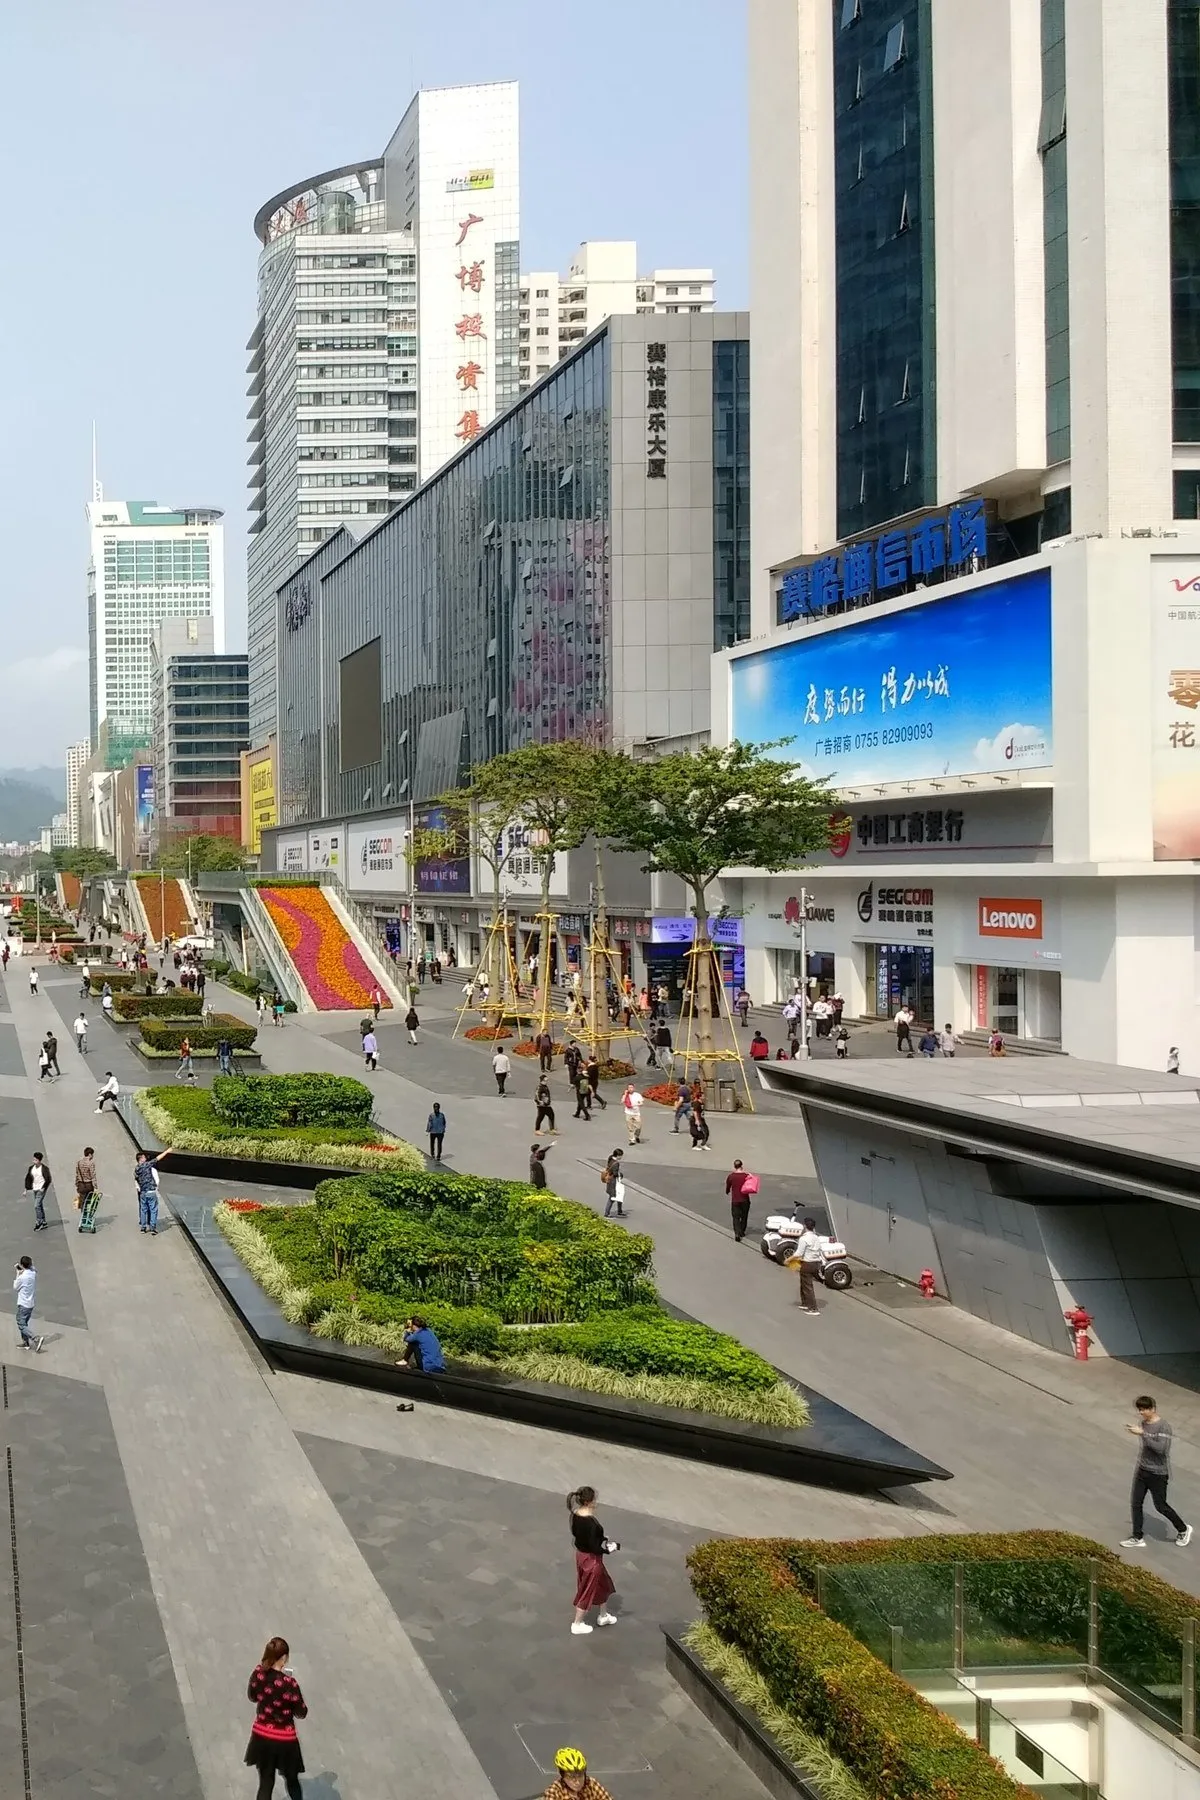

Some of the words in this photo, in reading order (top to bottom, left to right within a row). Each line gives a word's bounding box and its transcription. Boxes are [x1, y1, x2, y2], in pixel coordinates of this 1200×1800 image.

[455, 213, 488, 442] 广博投资集
[647, 342, 667, 480] 赛格康乐大厦
[781, 498, 987, 621] 赛格通信市场
[814, 734, 852, 757] 广告招商
[854, 732, 879, 750] 0755
[882, 721, 934, 746] 82909093
[1168, 721, 1196, 749] 花
[857, 808, 963, 846] 中国工商银行
[878, 888, 933, 906] SEGCOM
[878, 910, 933, 923] 赛格通信市场
[982, 907, 1037, 930] Lenovo
[879, 959, 888, 1009] 手机维修中心
